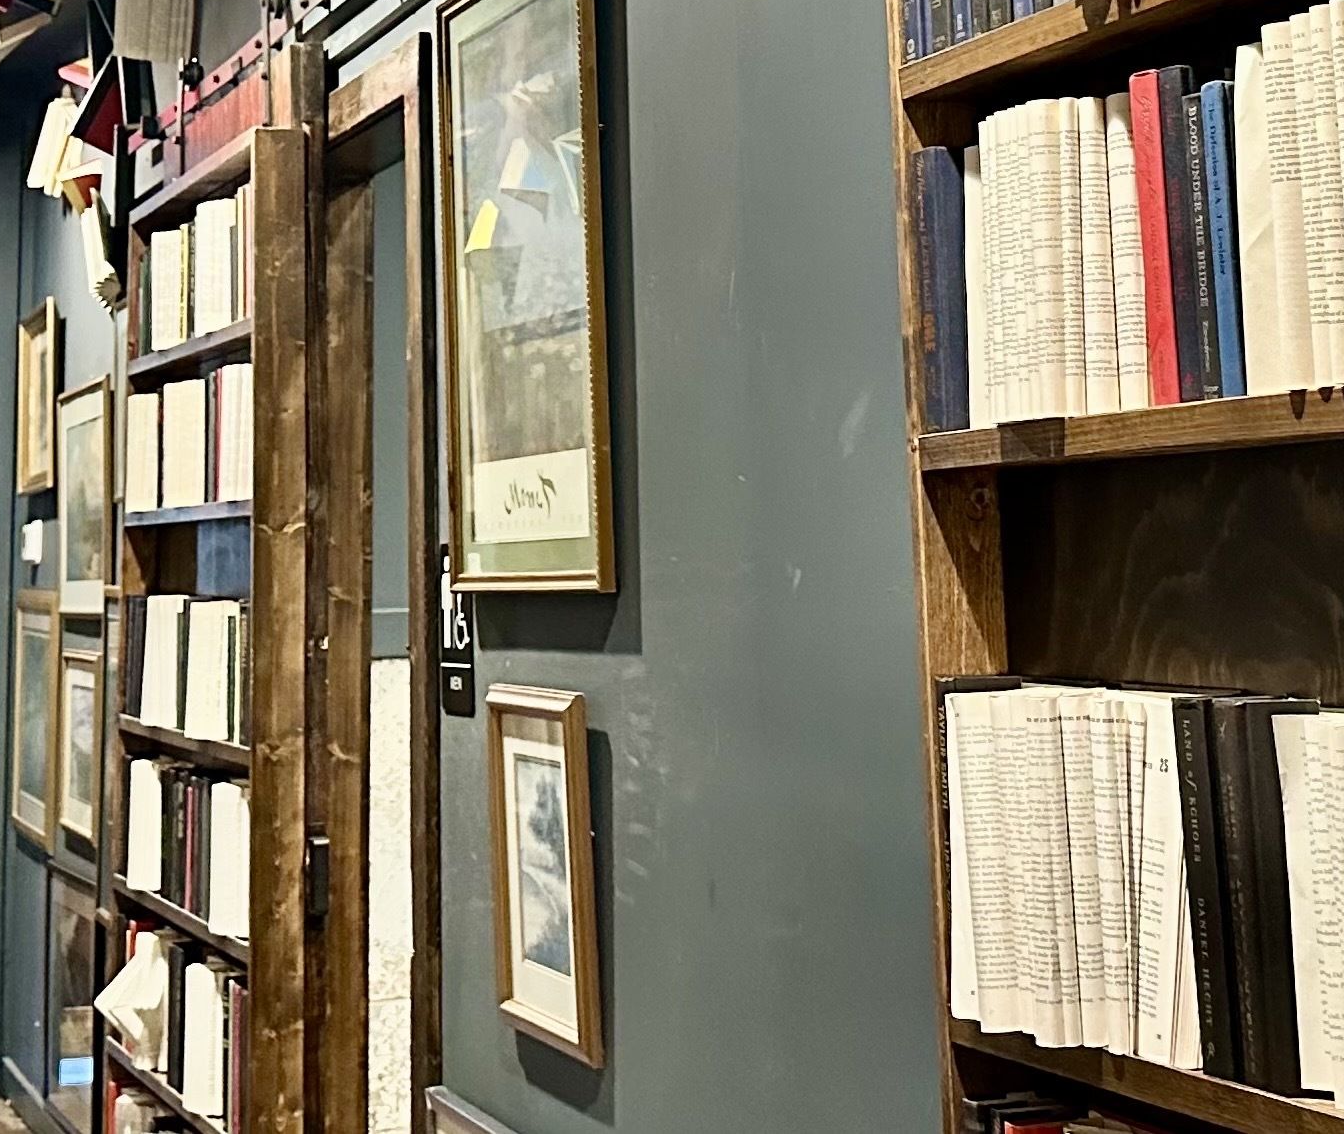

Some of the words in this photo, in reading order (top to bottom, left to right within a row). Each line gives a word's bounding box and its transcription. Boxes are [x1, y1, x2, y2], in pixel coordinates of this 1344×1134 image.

[1188, 104, 1200, 157] BLOOD
[1209, 123, 1220, 178] Defection
[1191, 159, 1203, 213] UNDER
[1194, 214, 1205, 248] THE
[1196, 248, 1208, 308] BRIDGE
[937, 705, 947, 752] TAYLOR
[1182, 718, 1194, 762] LAND
[940, 763, 949, 810] SMITH
[1185, 769, 1197, 794] of
[1188, 796, 1202, 864] ECHOES
[1197, 896, 1209, 962] DANIEL
[1201, 967, 1214, 1026] HECHT
